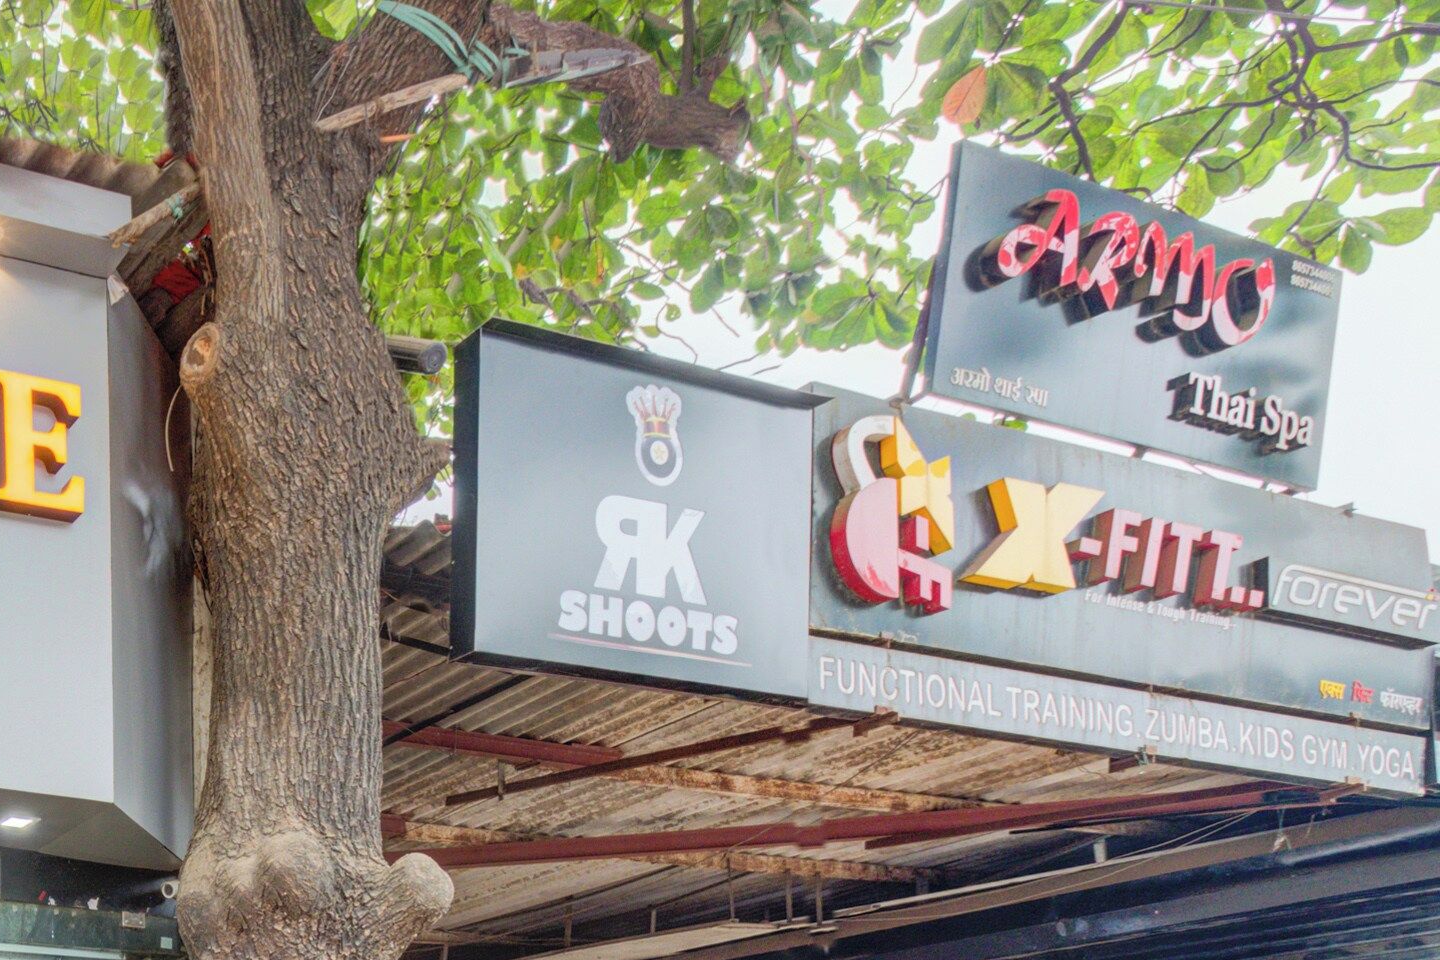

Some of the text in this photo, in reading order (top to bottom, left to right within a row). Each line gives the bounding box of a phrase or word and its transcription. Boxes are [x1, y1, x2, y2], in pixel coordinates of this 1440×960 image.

[1189, 372, 1315, 451] Thai Spa
[559, 590, 738, 655] SHOOTS
[1085, 589, 1101, 604] For
[1106, 594, 1144, 612] Intense
[1147, 602, 1155, 614] &
[1157, 603, 1186, 622] Tough
[819, 656, 1002, 717] FUNCTIONAL
[1239, 722, 1294, 761] KIDS
